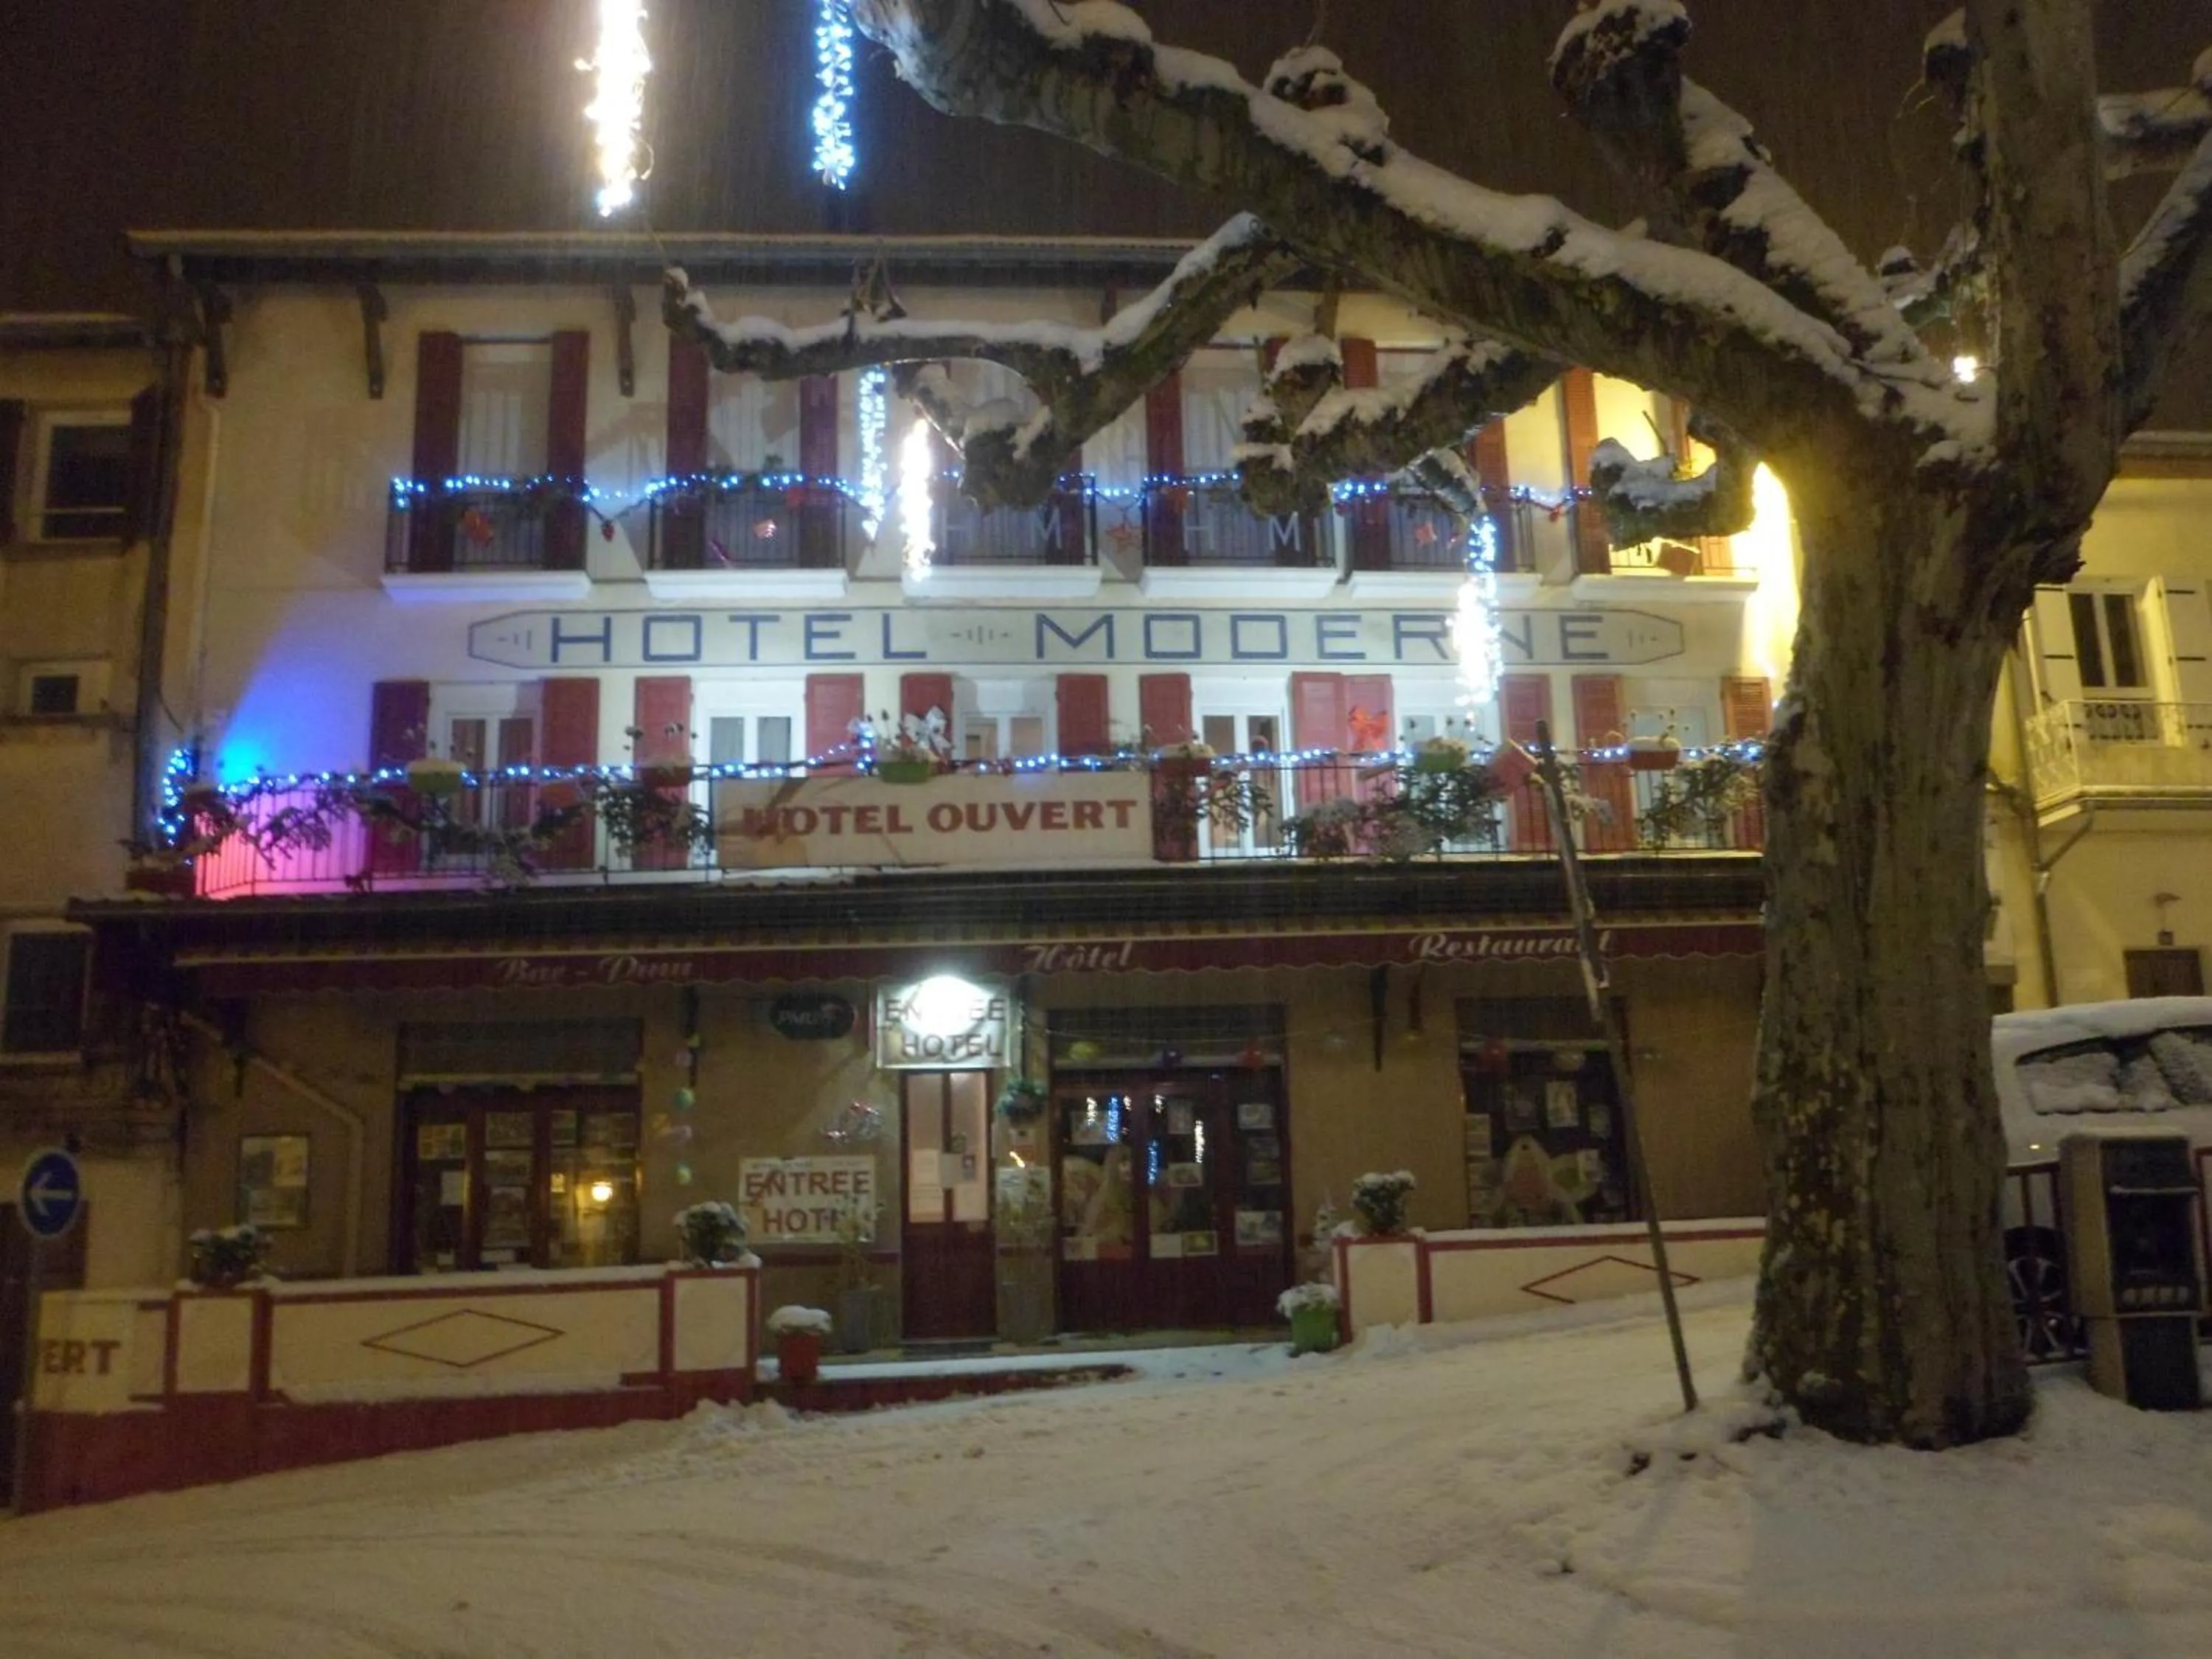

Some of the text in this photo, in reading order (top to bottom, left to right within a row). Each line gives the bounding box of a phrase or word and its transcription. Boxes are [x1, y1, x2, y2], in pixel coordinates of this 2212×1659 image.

[1029, 508, 1062, 549] M
[1183, 508, 1301, 552] H M
[551, 613, 1609, 662] HOTEL MODERNE
[742, 799, 1137, 837] HOTEL OUVERT
[1023, 940, 1133, 970] Hôtel
[1407, 929, 1613, 958] Restaurat
[885, 998, 1006, 1022] ENEE
[901, 1033, 1003, 1057] HOTEL
[745, 1169, 871, 1197] ENTREE
[762, 1206, 859, 1234] HOT
